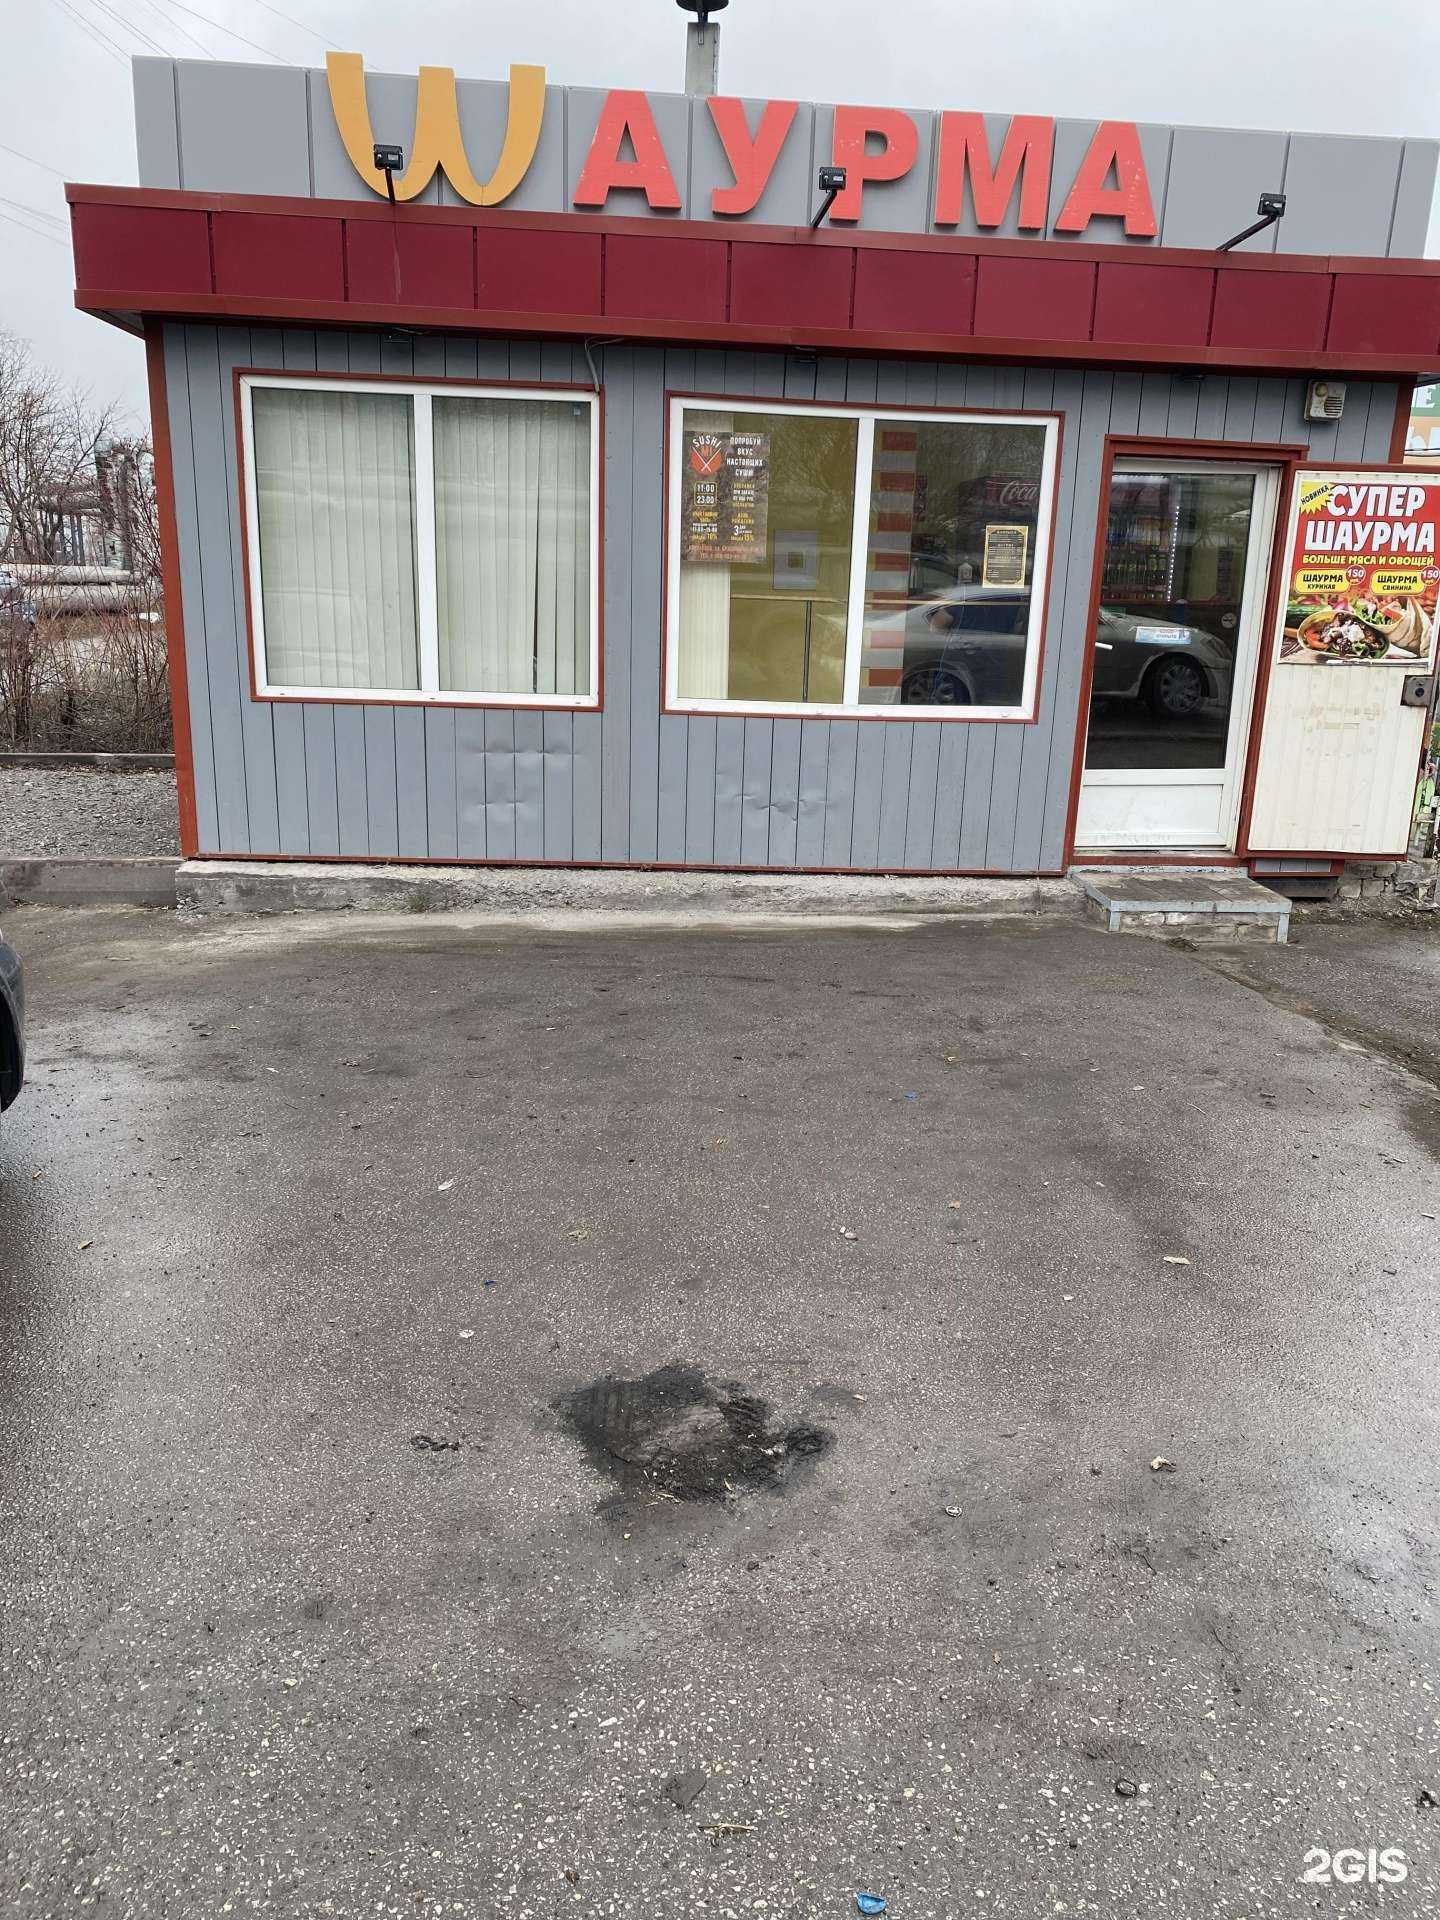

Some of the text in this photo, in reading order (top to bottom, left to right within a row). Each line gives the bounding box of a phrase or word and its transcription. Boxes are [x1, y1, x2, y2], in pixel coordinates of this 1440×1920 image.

[692, 435, 722, 448] SUSHI
[729, 436, 761, 446] ПОПРОБУЙ
[737, 448, 753, 456] ВКУС
[726, 458, 763, 467] НАСТОЯЩИХ
[735, 468, 754, 477] СУШИ
[696, 484, 715, 493] 11:00
[696, 495, 715, 504] 23:00
[1300, 484, 1330, 505] НОВИНКА
[1326, 485, 1426, 517] СУПЕР
[1304, 520, 1435, 553] ШАУРМА
[1302, 555, 1435, 566] БОЛЬШЕ МЯСА И ОВОЩЕЙ
[1302, 574, 1344, 583] ШАУРМА
[1347, 569, 1365, 579] 150
[1422, 570, 1438, 580] 150
[1377, 575, 1418, 584] ШАУРМА
